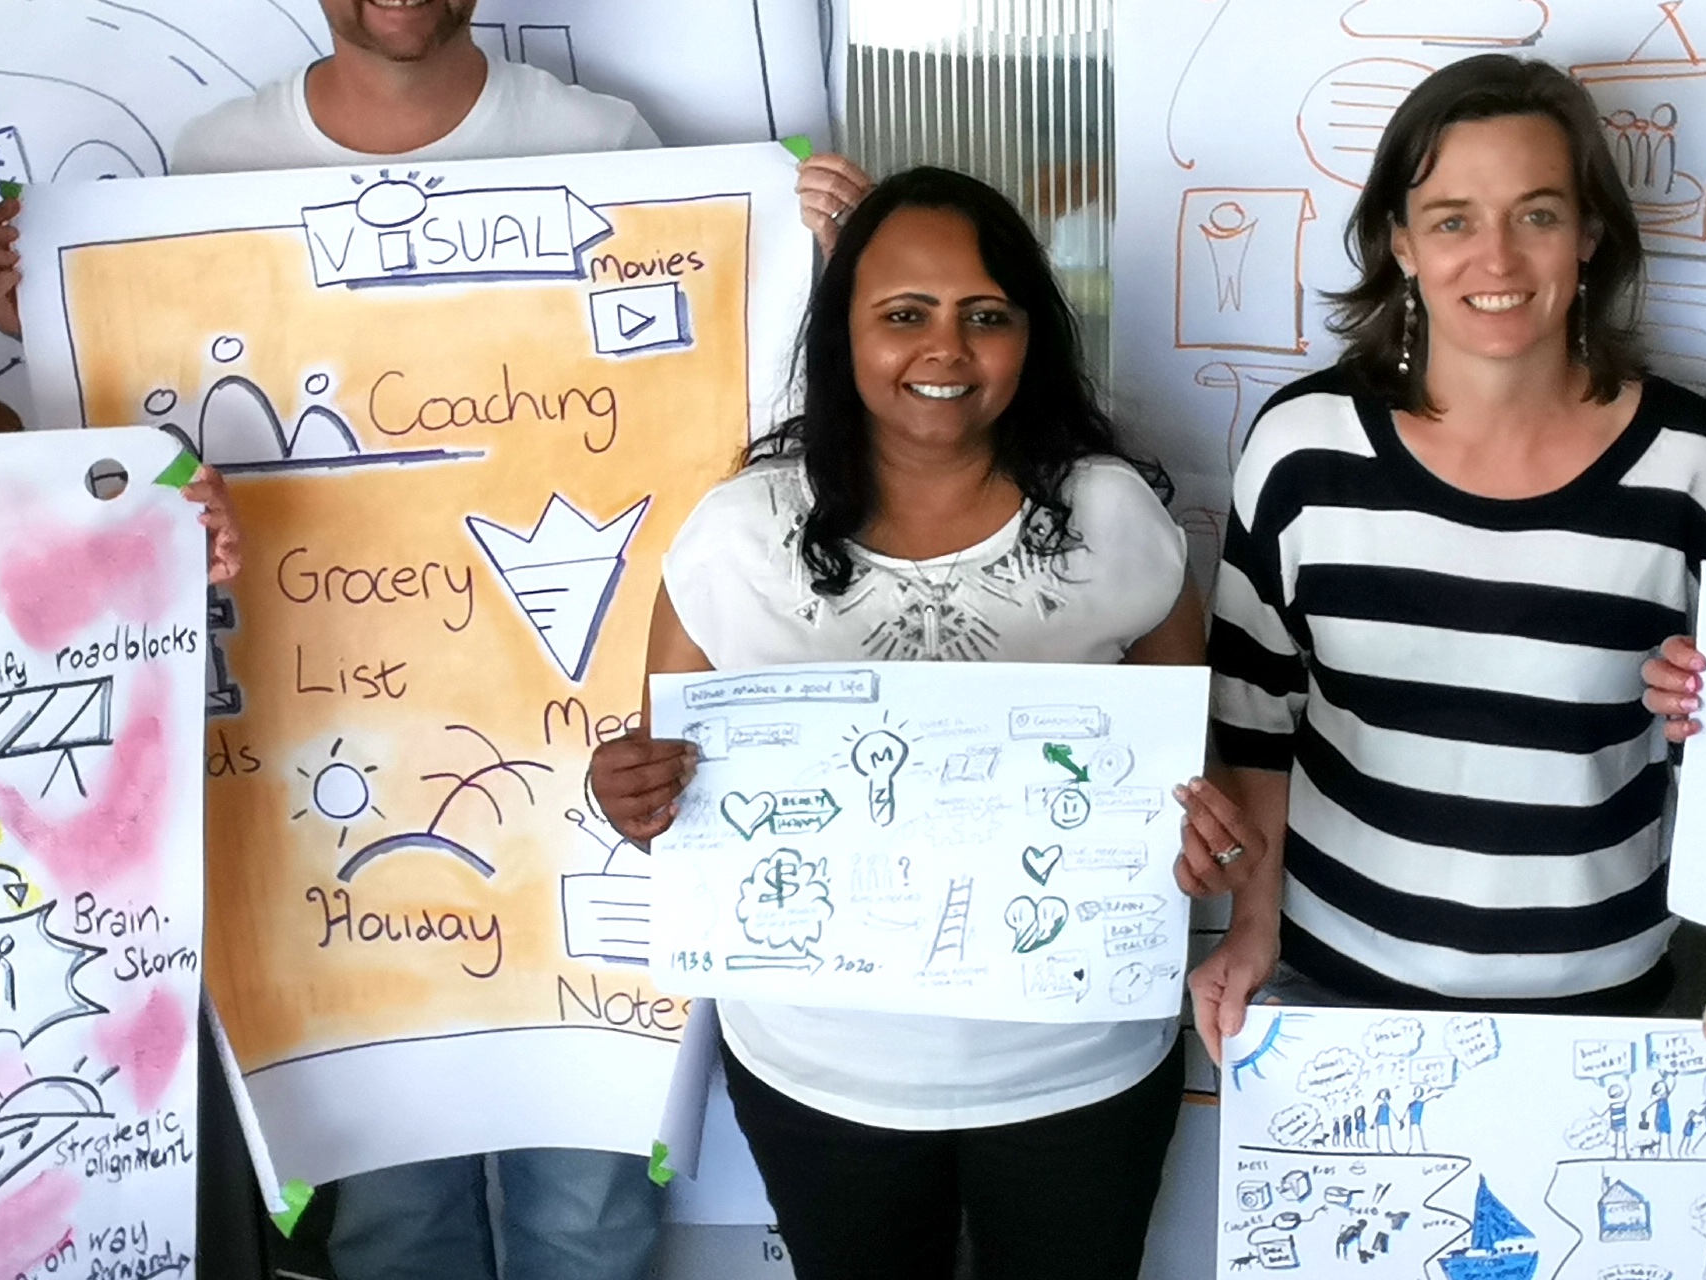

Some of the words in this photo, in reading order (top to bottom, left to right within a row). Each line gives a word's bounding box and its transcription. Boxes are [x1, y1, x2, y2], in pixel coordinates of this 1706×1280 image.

[368, 363, 619, 453] Coaching
[277, 546, 474, 632] Grocery
[296, 643, 407, 699] List
[304, 885, 503, 978] Holiday
[113, 945, 198, 982] Storm
[55, 1111, 181, 1167] Strategic
[84, 1133, 193, 1183] alignment
[44, 1235, 77, 1273] on
[87, 1220, 149, 1255] way
